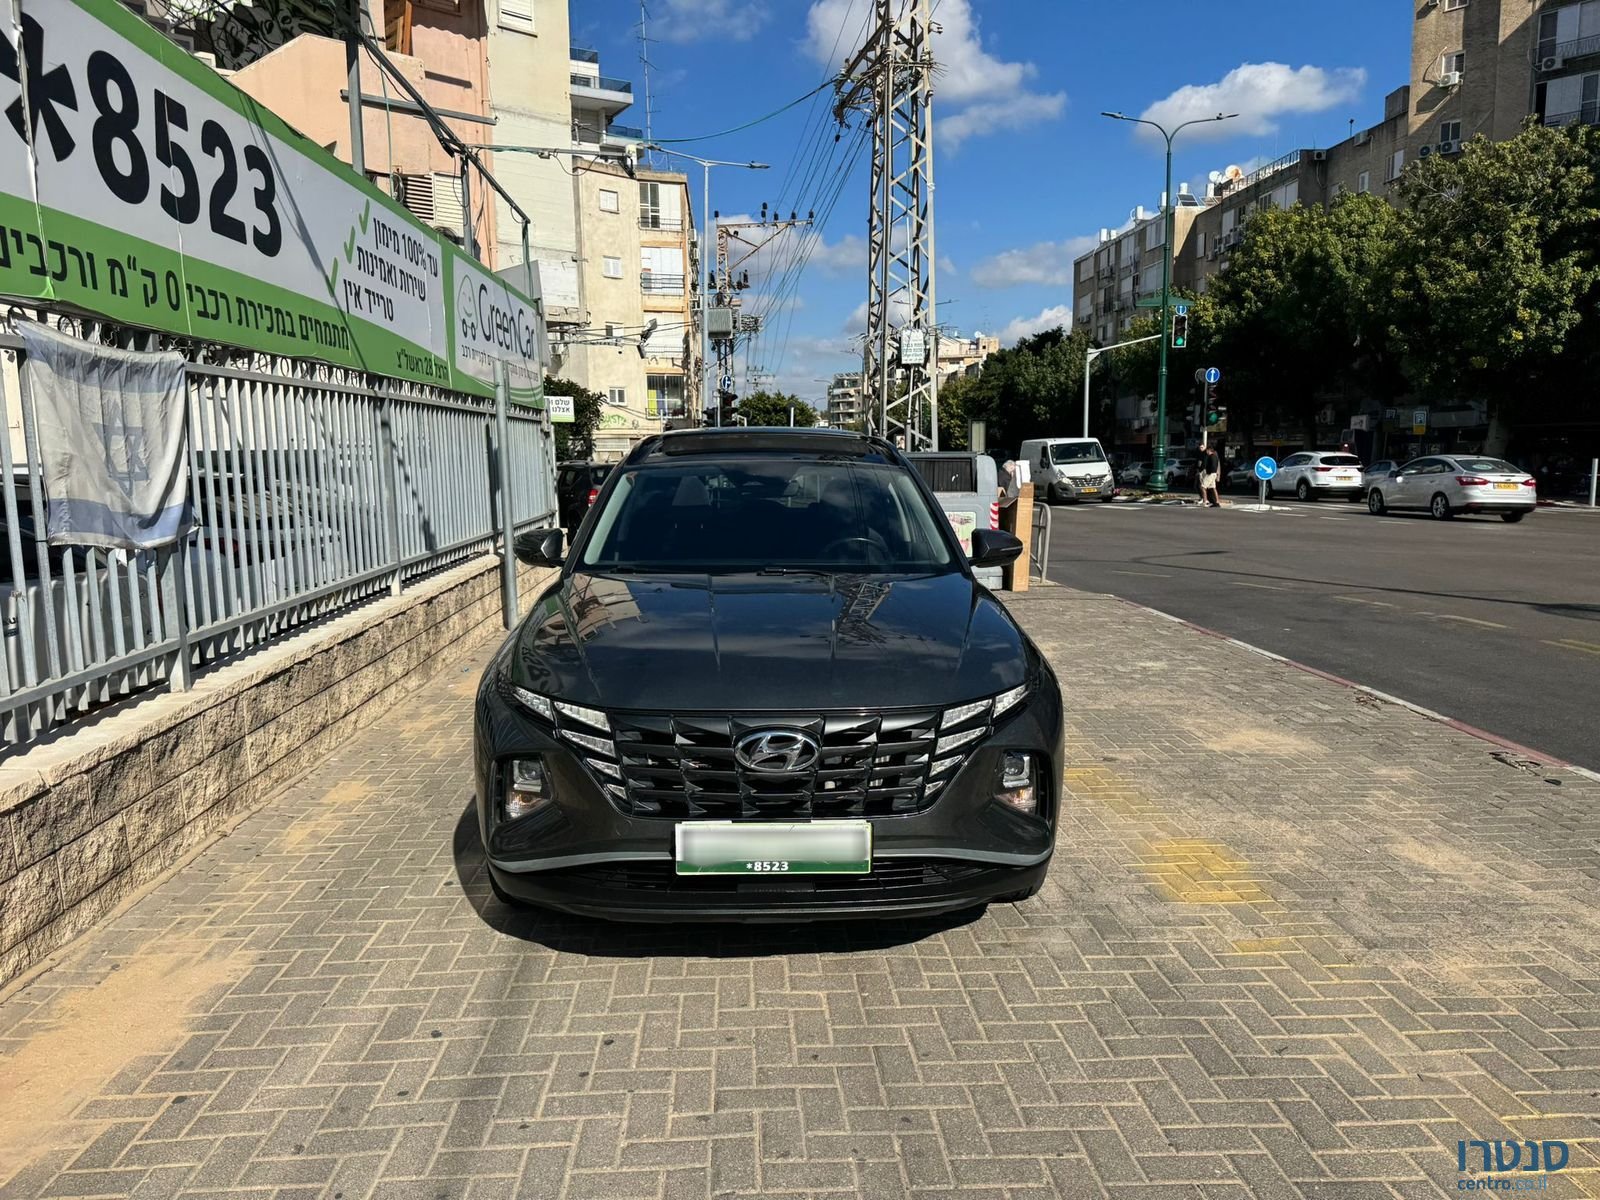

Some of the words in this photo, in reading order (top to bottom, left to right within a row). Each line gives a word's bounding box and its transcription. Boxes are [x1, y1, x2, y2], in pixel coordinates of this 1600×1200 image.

[373, 217, 400, 255] מימון
[402, 233, 427, 270] 100%
[357, 245, 398, 288] ואמינות
[426, 253, 438, 278] עד
[165, 269, 180, 312] 0
[343, 278, 363, 314] אין
[399, 268, 426, 301] שירות
[186, 283, 233, 324] רכבי
[235, 296, 297, 338] במכירת
[364, 287, 394, 322] טרייד
[298, 313, 350, 351] מתמחים
[424, 356, 433, 376] 28
[551, 405, 570, 413] אצלנו
